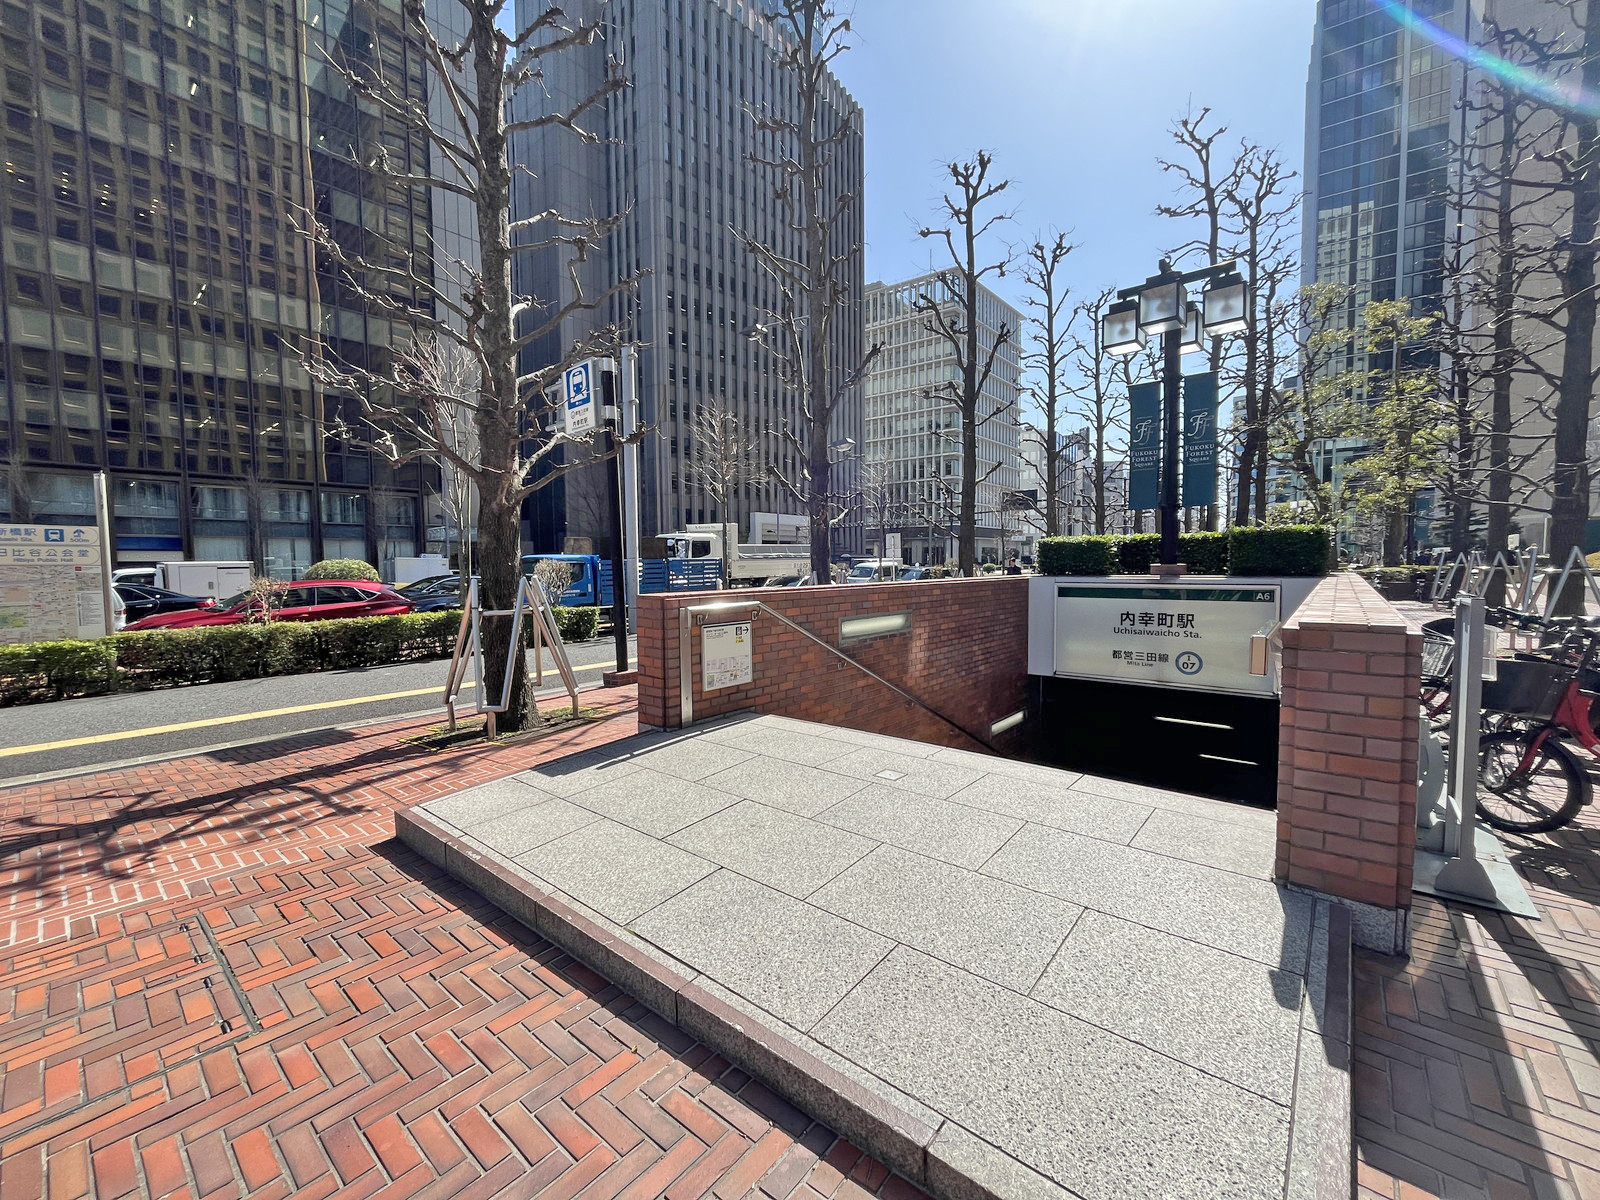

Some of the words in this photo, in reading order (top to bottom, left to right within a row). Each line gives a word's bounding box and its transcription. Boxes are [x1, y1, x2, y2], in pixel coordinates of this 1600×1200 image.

[1185, 444, 1215, 452] FUKOKU
[0, 548, 89, 557] 日比谷公会堂
[1256, 592, 1271, 601] A6
[1120, 611, 1195, 629] 内幸町駅
[1113, 626, 1181, 638] Uchisaiwaicho
[1183, 630, 1203, 639] Sta.
[1112, 650, 1169, 663] 都営三田線
[1181, 661, 1197, 670] 07
